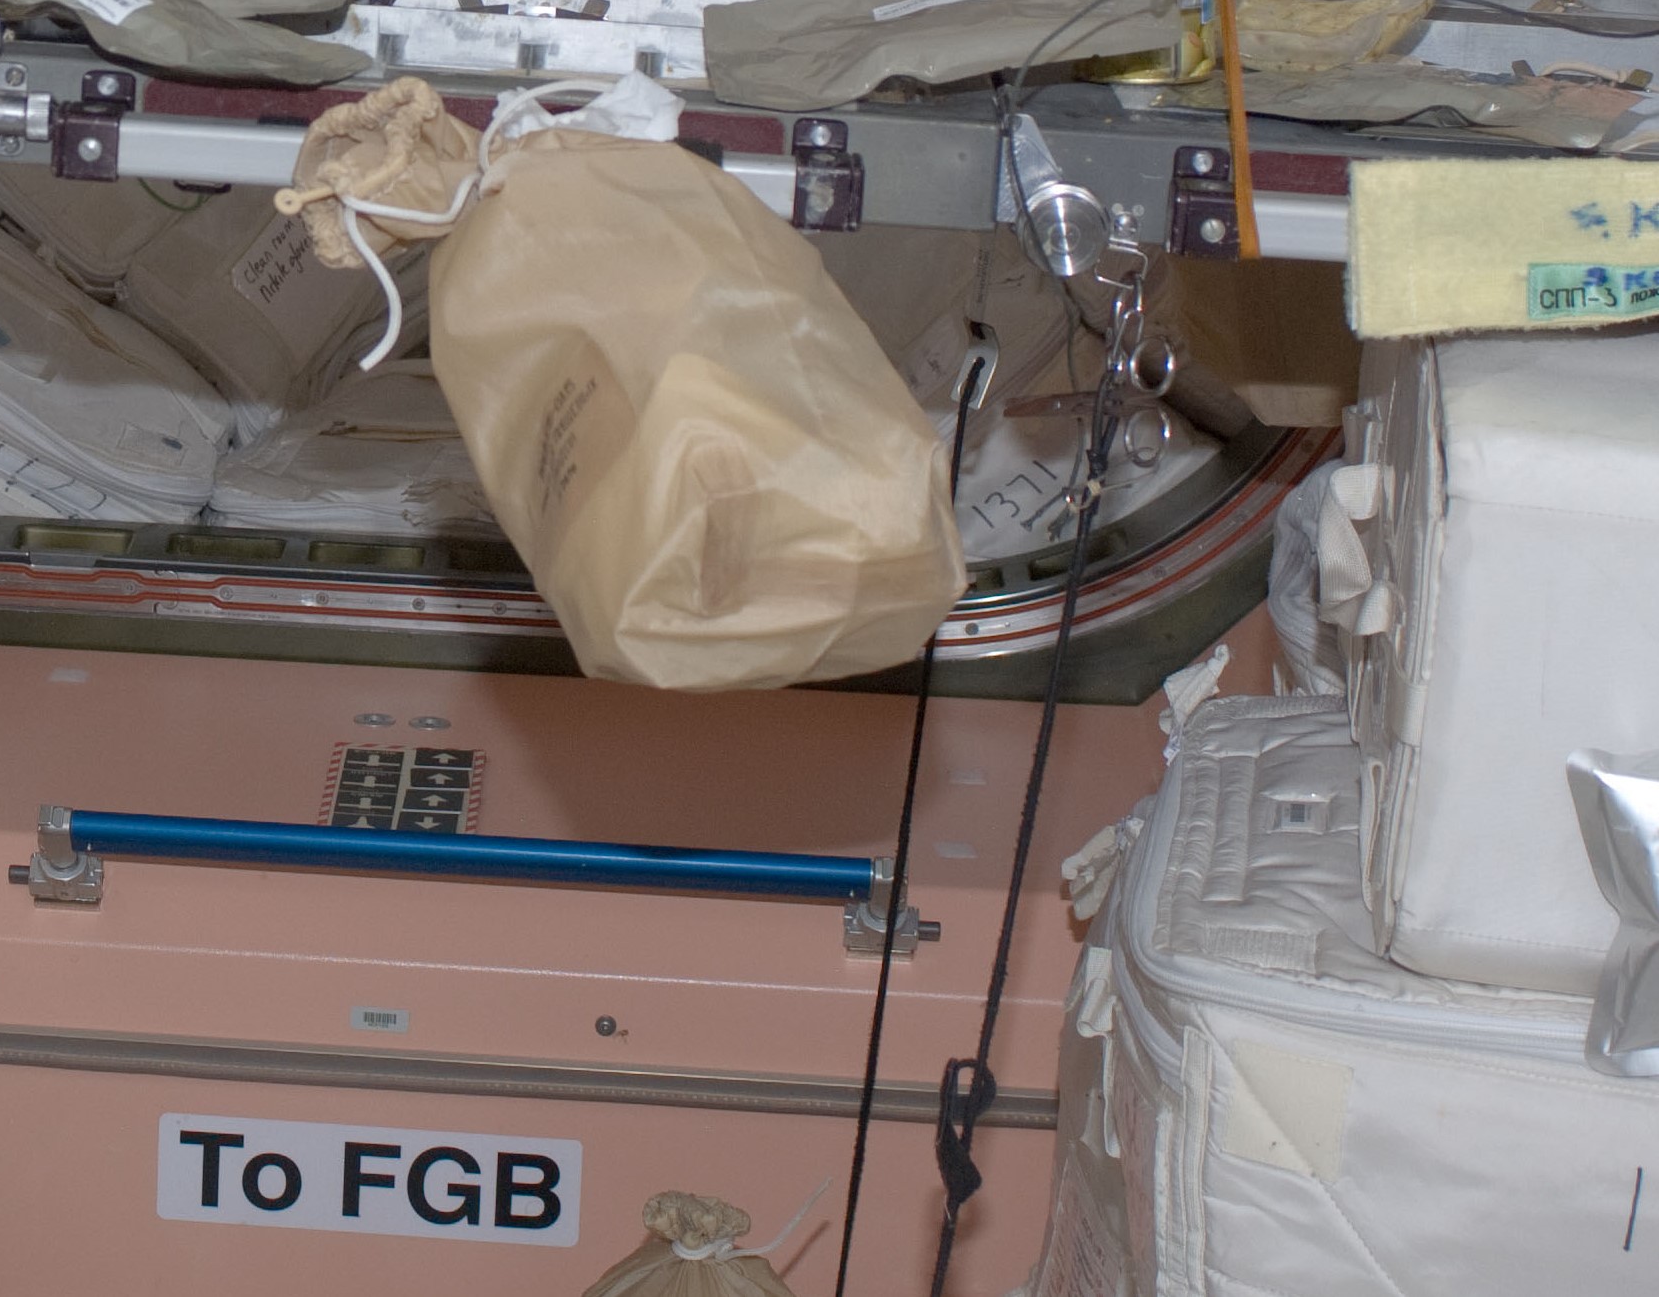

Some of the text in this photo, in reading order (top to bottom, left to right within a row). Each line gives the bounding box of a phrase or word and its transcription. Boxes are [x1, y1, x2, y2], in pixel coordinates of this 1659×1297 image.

[243, 249, 274, 284] Clean
[970, 459, 1058, 530] 1371
[180, 1129, 562, 1230] To FGB
